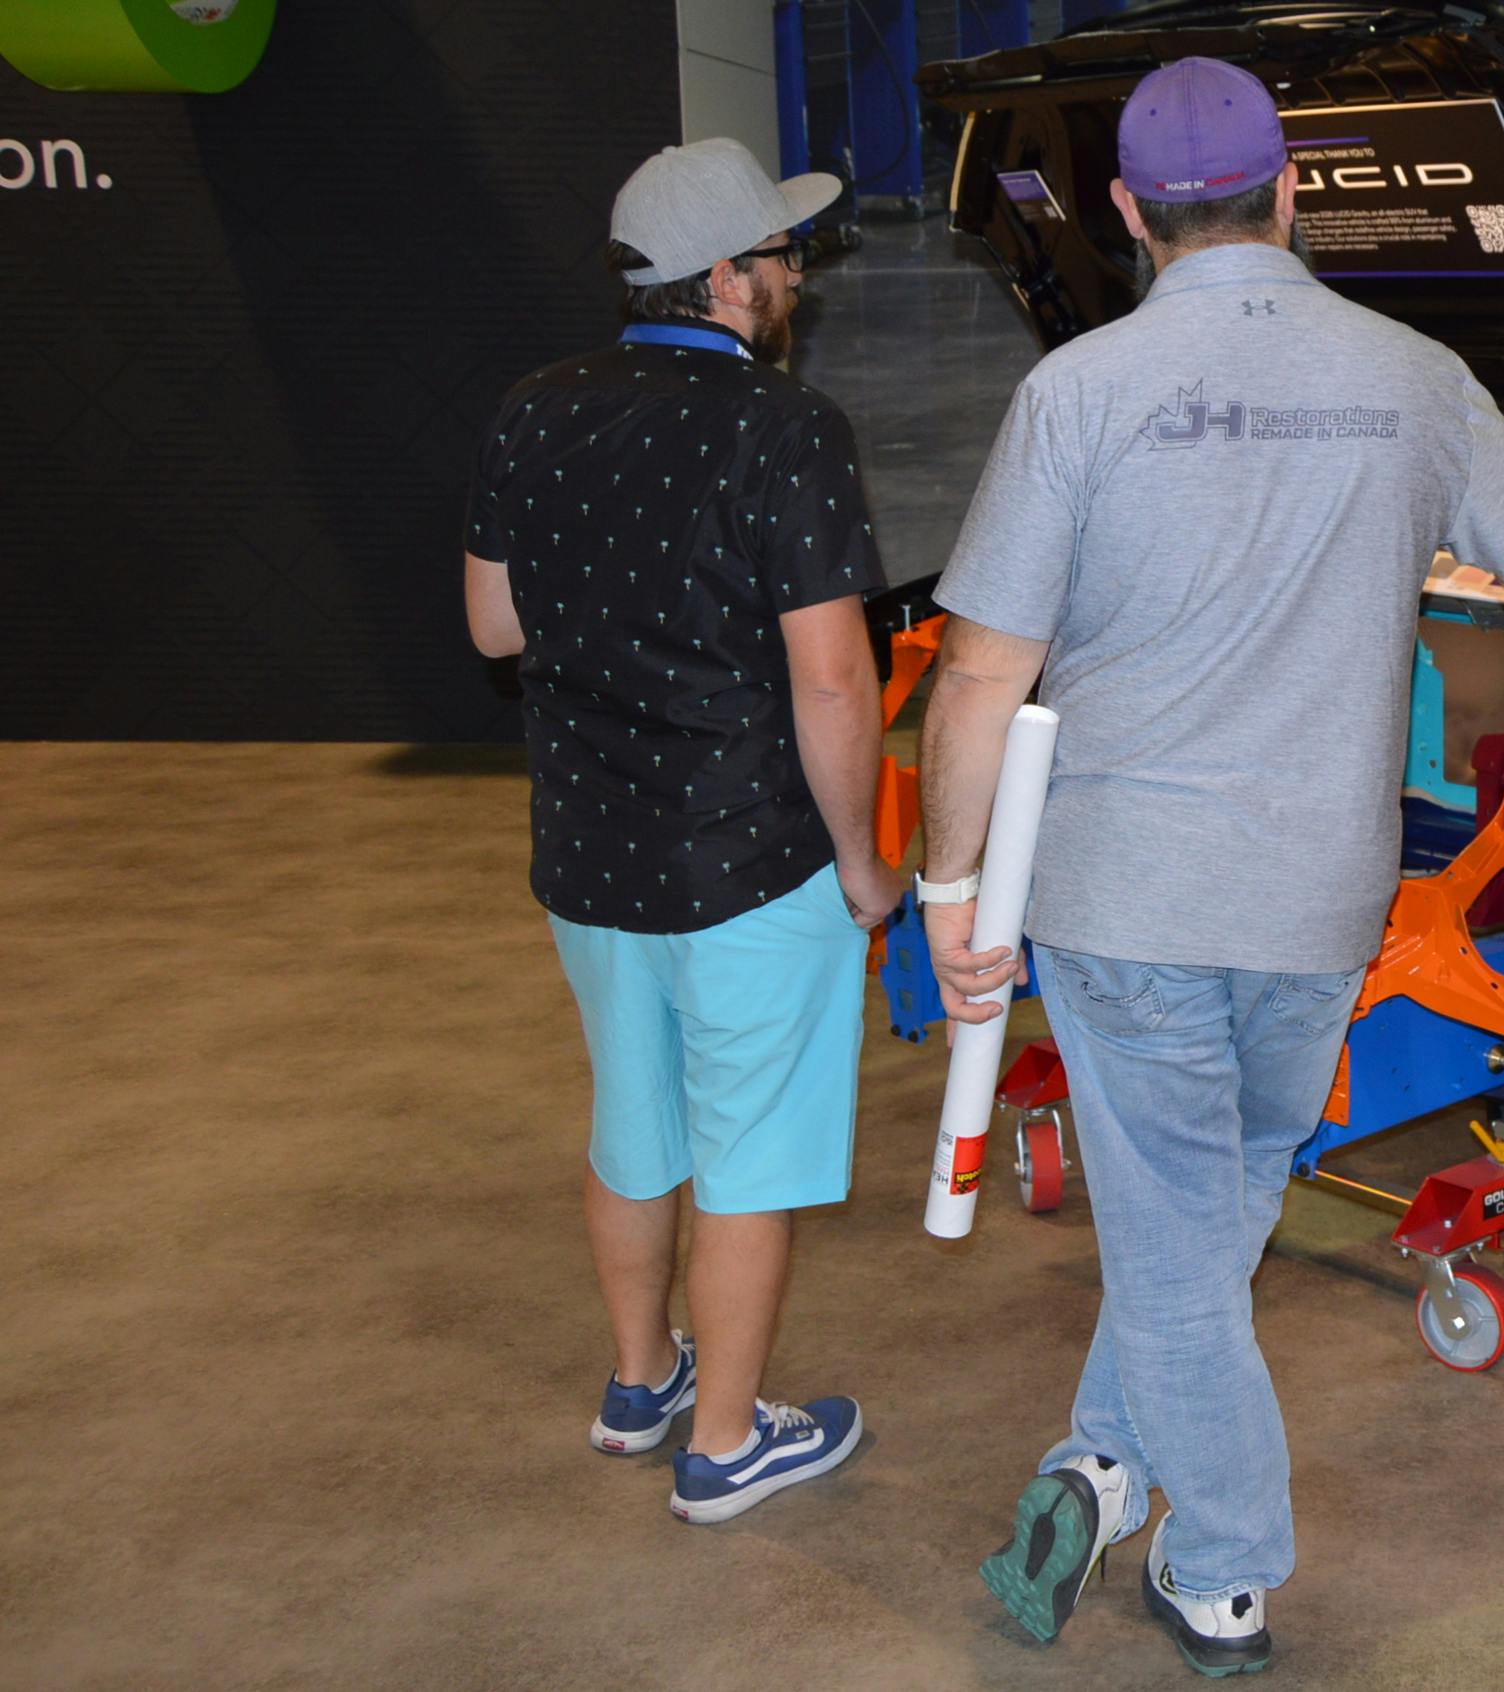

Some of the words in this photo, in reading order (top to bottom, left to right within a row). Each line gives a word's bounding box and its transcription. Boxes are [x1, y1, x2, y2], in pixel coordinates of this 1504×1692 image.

[1297, 151, 1325, 161] SPECIAL
[1324, 150, 1349, 160] THANK
[1349, 148, 1364, 159] YOU
[1363, 147, 1376, 157] TO
[0, 139, 113, 190] on.
[1193, 179, 1205, 189] IN
[1295, 162, 1474, 191] UCID
[1250, 406, 1400, 427] Restorations
[1250, 427, 1313, 441] REMADE
[1316, 427, 1332, 441] IN
[1335, 426, 1399, 439] CANADA
